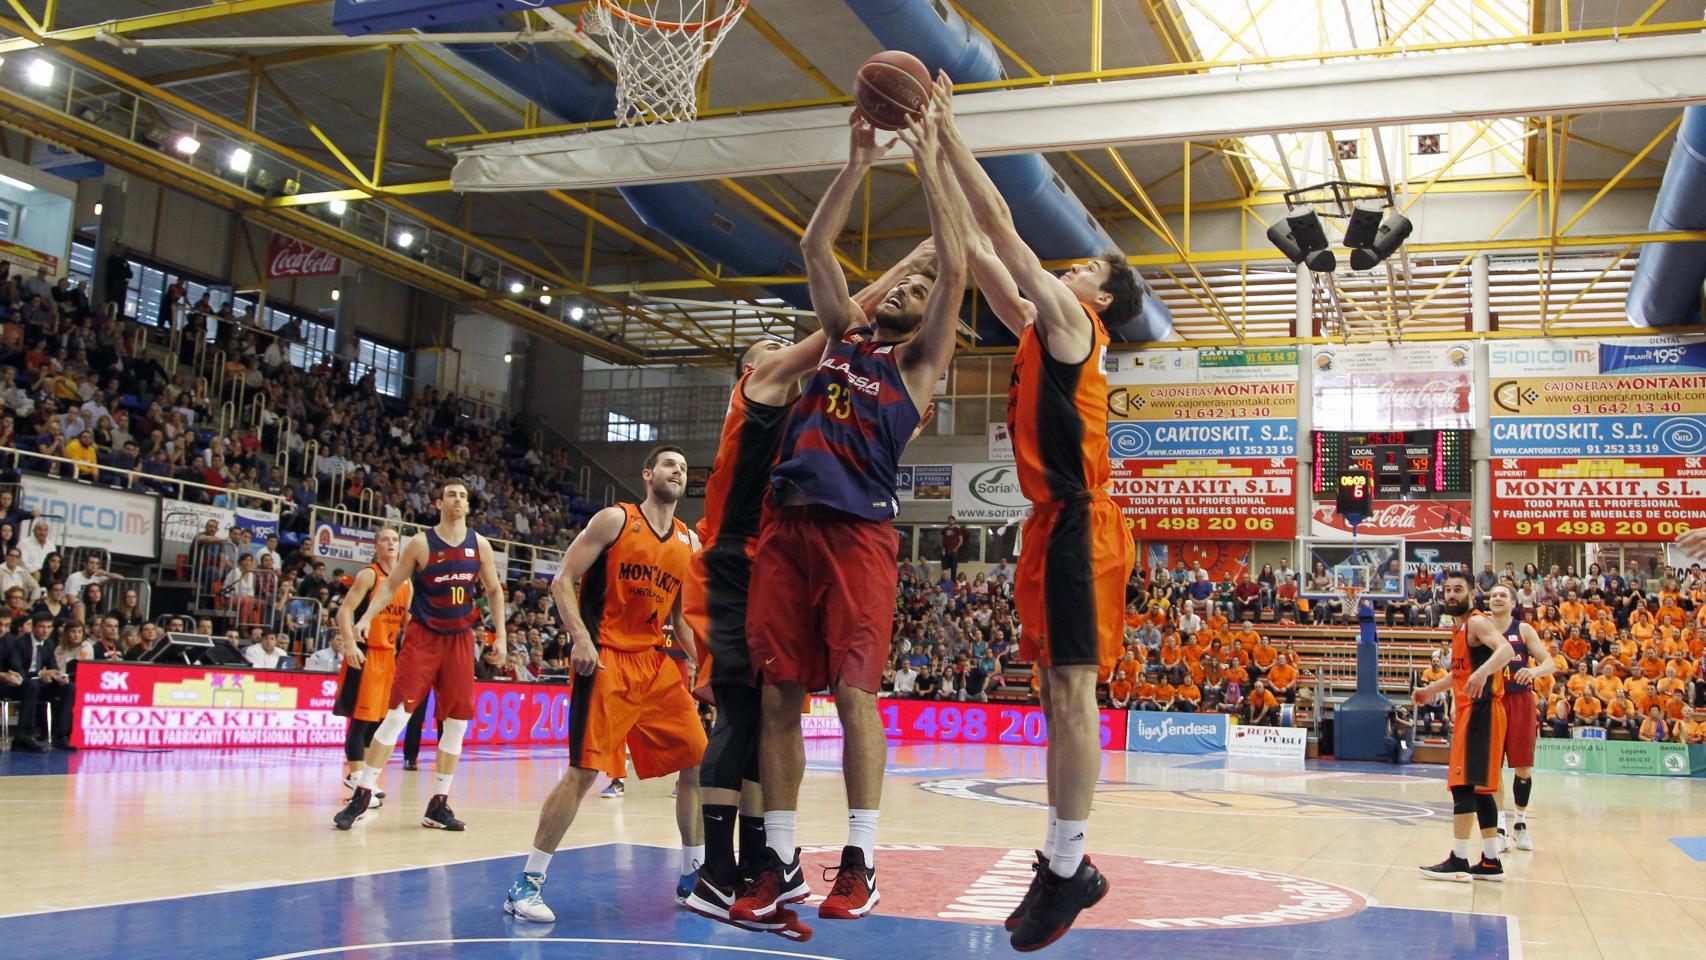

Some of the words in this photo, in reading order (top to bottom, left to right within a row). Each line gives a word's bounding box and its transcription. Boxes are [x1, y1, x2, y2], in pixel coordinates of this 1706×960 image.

[271, 247, 336, 276] Coca-Cola
[1150, 386, 1213, 398] CAJONERAS
[1213, 383, 1295, 397] MONTAKIT
[1544, 380, 1614, 392] CAJONERAS
[1616, 376, 1706, 390] MONTAKIT
[826, 383, 851, 420] 33
[1150, 397, 1296, 410] www.cajonerasmontakit.com
[1572, 403, 1592, 414] 91
[1597, 402, 1629, 414] 642
[1635, 402, 1655, 413] 13
[1660, 401, 1682, 413] 40
[1174, 409, 1192, 419] 91
[1197, 408, 1224, 419] 642
[1230, 408, 1247, 418] 13
[1252, 407, 1270, 418] 40
[1260, 424, 1294, 442] S.L.
[1611, 422, 1648, 440] S.L.
[1147, 448, 1224, 456] WWW.CANTOSKIT.COM
[1229, 446, 1242, 456] 91
[1244, 446, 1263, 455] 252
[1265, 446, 1279, 455] 33
[1281, 445, 1294, 455] 19
[1351, 448, 1375, 456] LOCAL
[1494, 447, 1581, 455] WWW.CANTOSKIT.COM
[1586, 444, 1601, 454] 91
[1603, 444, 1625, 454] 252
[1627, 444, 1642, 454] 33
[1645, 444, 1660, 454] 19
[1270, 458, 1286, 468] SK
[1357, 459, 1373, 471] 46
[1412, 458, 1429, 470] 49
[1502, 458, 1518, 469] SK
[1685, 457, 1702, 468] SK
[978, 483, 1020, 494] SoriaN
[1113, 480, 1239, 496] MONTAKIT,
[1245, 479, 1284, 494] S.L.
[1354, 485, 1364, 498] 6
[1505, 480, 1648, 498] MONTAKIT,
[1656, 480, 1700, 496] S.L.
[1129, 497, 1155, 505] TODO
[1157, 497, 1182, 505] PARA
[1186, 497, 1196, 505] EL
[1199, 496, 1266, 505] PROFESIONAL
[1524, 499, 1553, 508] TODO
[1557, 499, 1585, 508] PARA
[1588, 499, 1600, 508] EL
[1604, 499, 1680, 508] PROFESIONAL
[957, 507, 1022, 518] www.sorian
[1122, 507, 1168, 515] BRICANTE
[1172, 507, 1184, 515] DE
[1187, 507, 1232, 515] MUEBLES
[1236, 507, 1246, 515] DE
[1250, 506, 1295, 515] COCINAS
[1493, 510, 1500, 518] Y
[1503, 510, 1570, 518] FABRICANTE
[1573, 510, 1587, 518] DE
[1590, 510, 1643, 518] MUEBLES
[1646, 510, 1660, 518] DE
[1664, 510, 1706, 518] COCINA
[1125, 518, 1148, 530] 91
[1156, 517, 1200, 530] 498
[1207, 517, 1237, 530] 20
[1244, 517, 1274, 530] 06
[1515, 521, 1546, 535] 91
[1556, 521, 1606, 535] 498
[1615, 521, 1648, 535] 20
[1657, 521, 1691, 535] 06
[450, 586, 465, 605] 10
[100, 671, 129, 691] SK
[83, 693, 140, 705] SUPERKIT
[293, 712, 345, 728] S.L.
[470, 691, 520, 742] 98
[531, 692, 570, 741] 20
[913, 706, 988, 742] 498
[1000, 709, 1047, 743] 20
[1168, 722, 1217, 736] endesa
[83, 730, 115, 746] TODO
[117, 729, 146, 745] PARA
[148, 729, 161, 744] EL
[163, 729, 223, 744] FABRICANTE
[225, 729, 232, 743] Y
[234, 729, 295, 744] PROFESIONAL
[296, 729, 307, 744] DE
[309, 729, 346, 744] COCINAS
[1247, 727, 1280, 737] REPA
[1264, 736, 1302, 745] PUBLI
